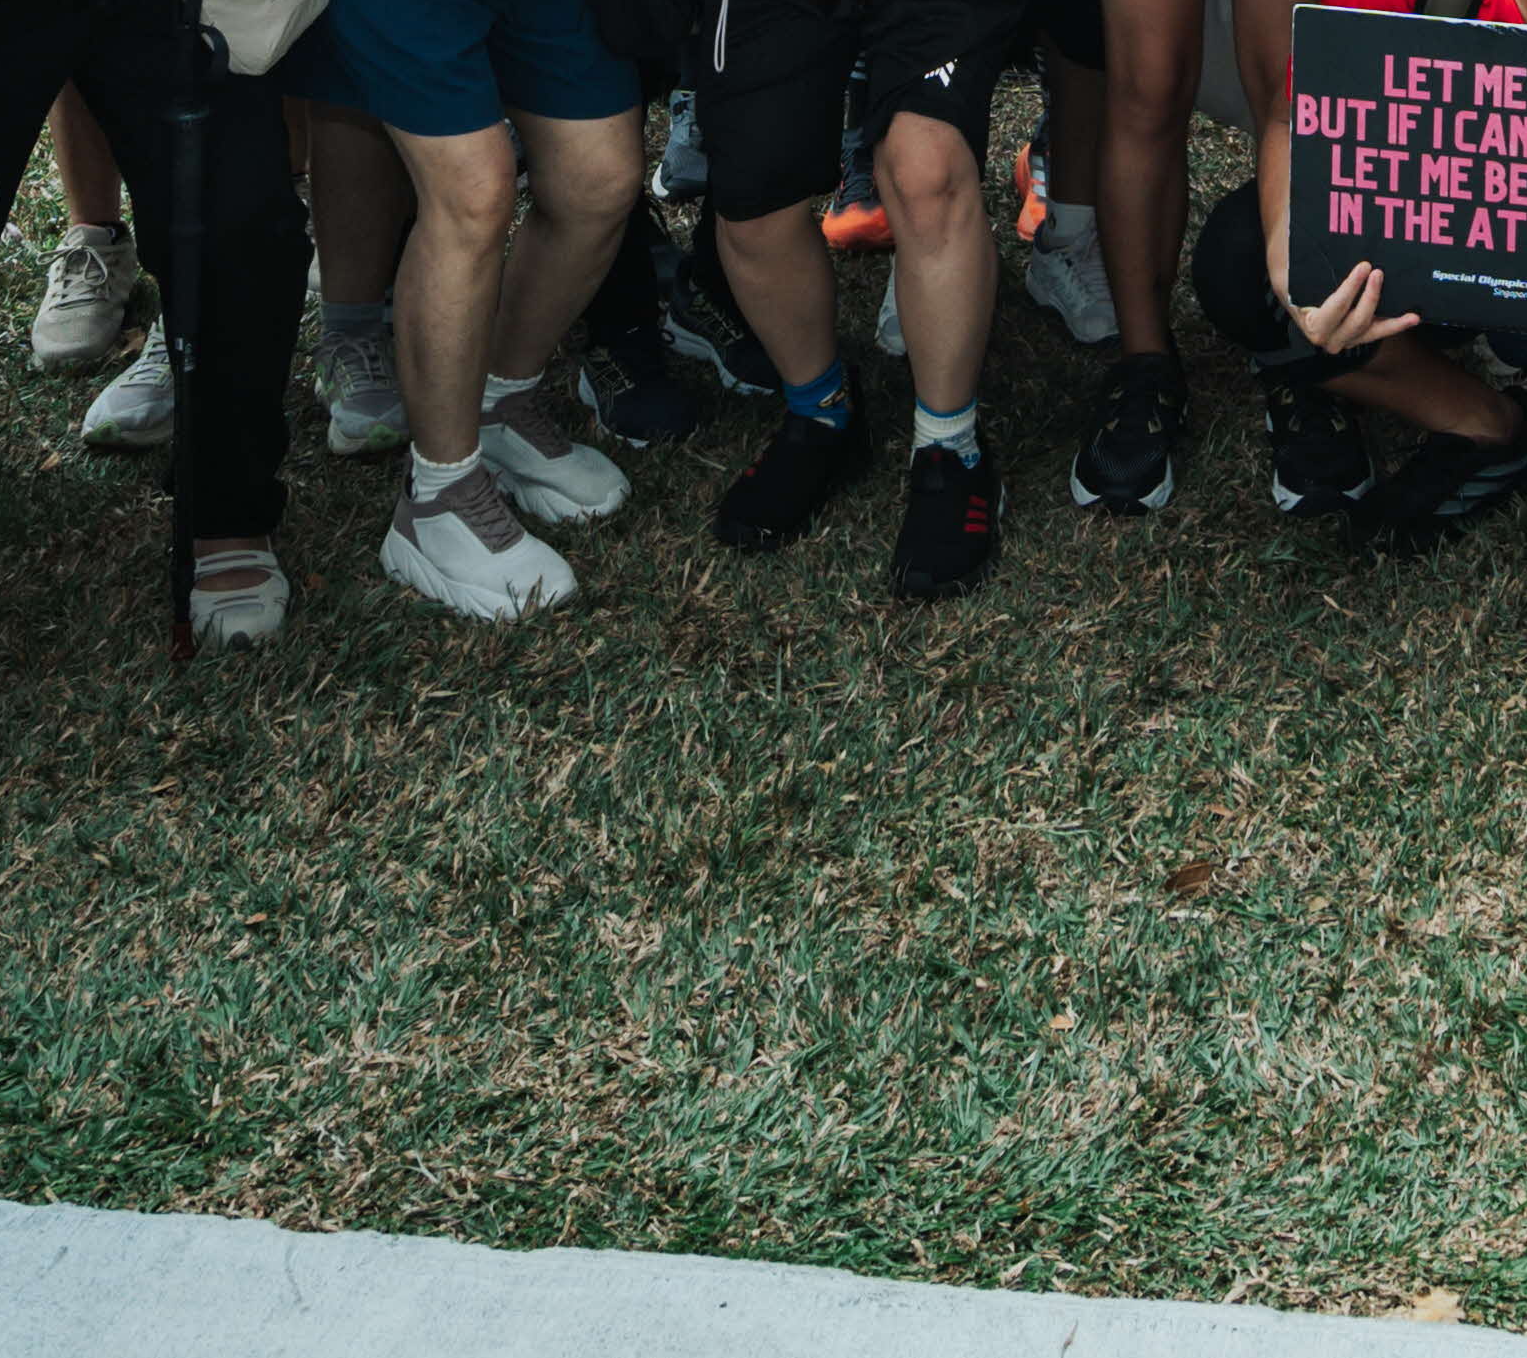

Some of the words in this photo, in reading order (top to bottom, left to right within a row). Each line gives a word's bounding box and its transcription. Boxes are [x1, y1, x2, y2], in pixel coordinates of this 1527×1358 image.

[1383, 54, 1462, 103] LET
[1473, 63, 1527, 111] ME
[1296, 93, 1377, 142] BUT
[1387, 101, 1422, 145] IF
[1432, 106, 1444, 150] I
[1330, 144, 1410, 193] LET
[1420, 154, 1473, 200] ME
[1329, 191, 1363, 236] IN
[1374, 197, 1455, 245] THE
[1433, 270, 1476, 284] Special
